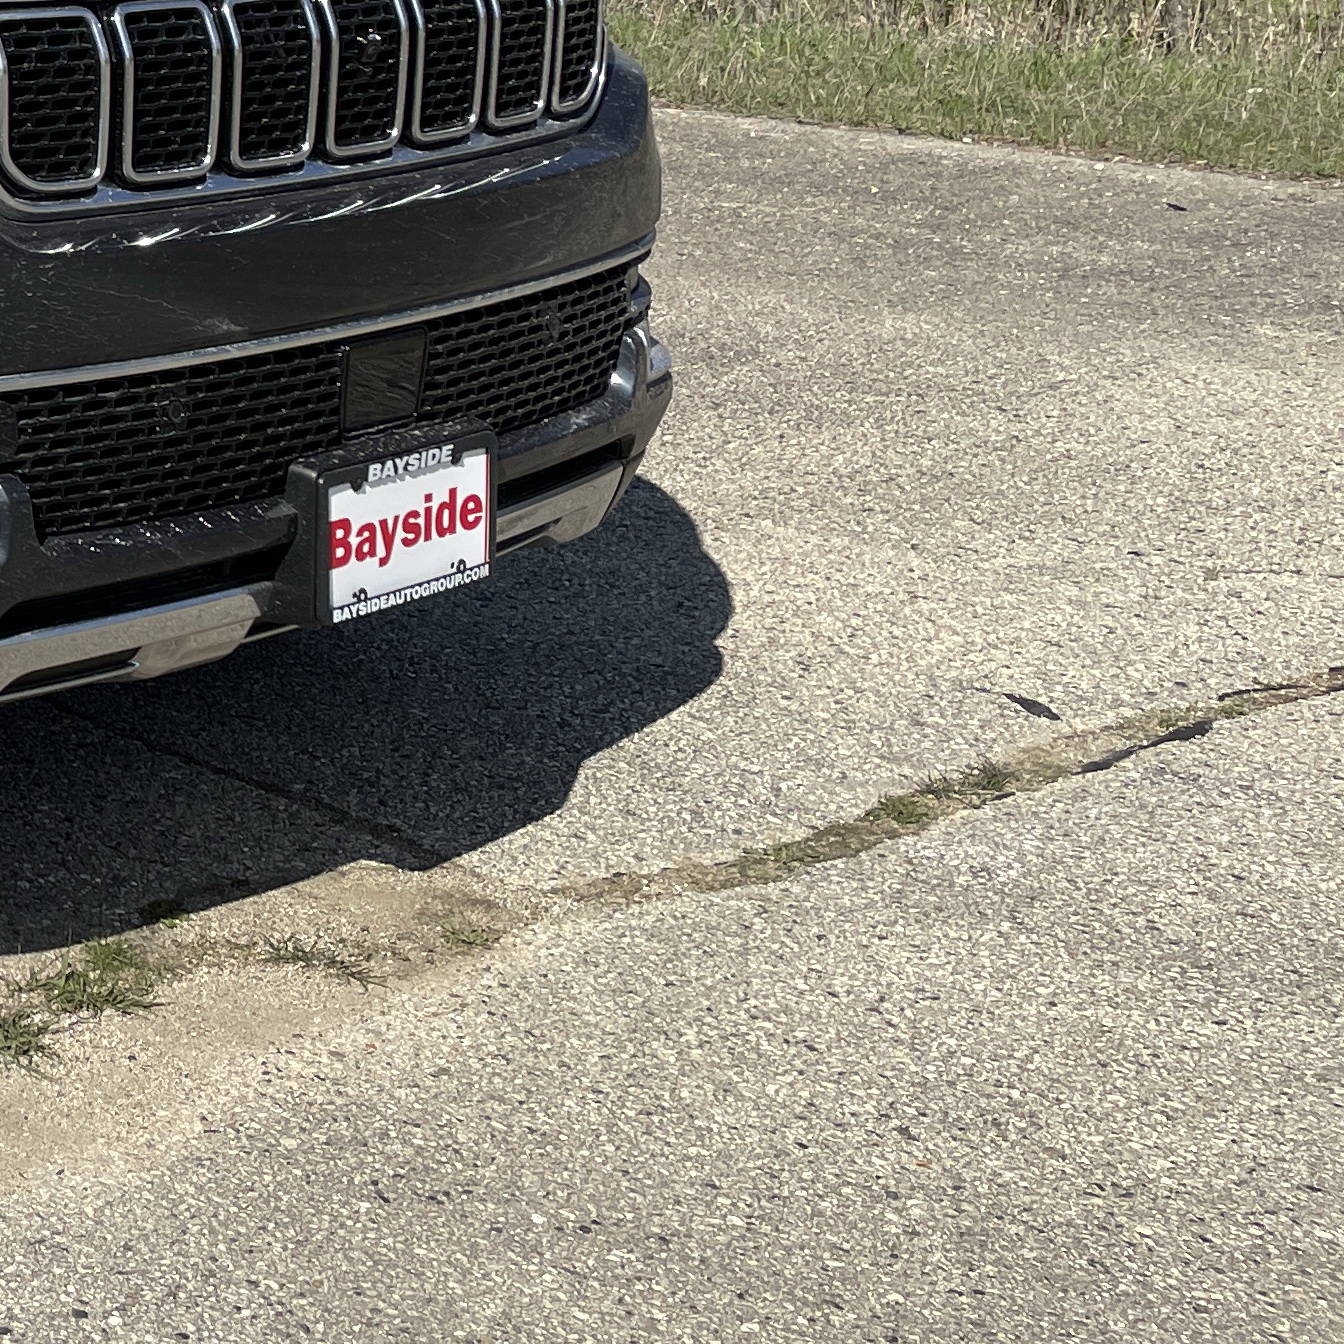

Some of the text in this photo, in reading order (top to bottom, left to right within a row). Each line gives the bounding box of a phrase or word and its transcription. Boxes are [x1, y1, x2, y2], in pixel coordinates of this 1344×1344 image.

[368, 444, 454, 482] BAYSIDE
[328, 487, 483, 571] Bayside
[332, 564, 490, 623] BAYSIDEAUTOGROUP.COM
